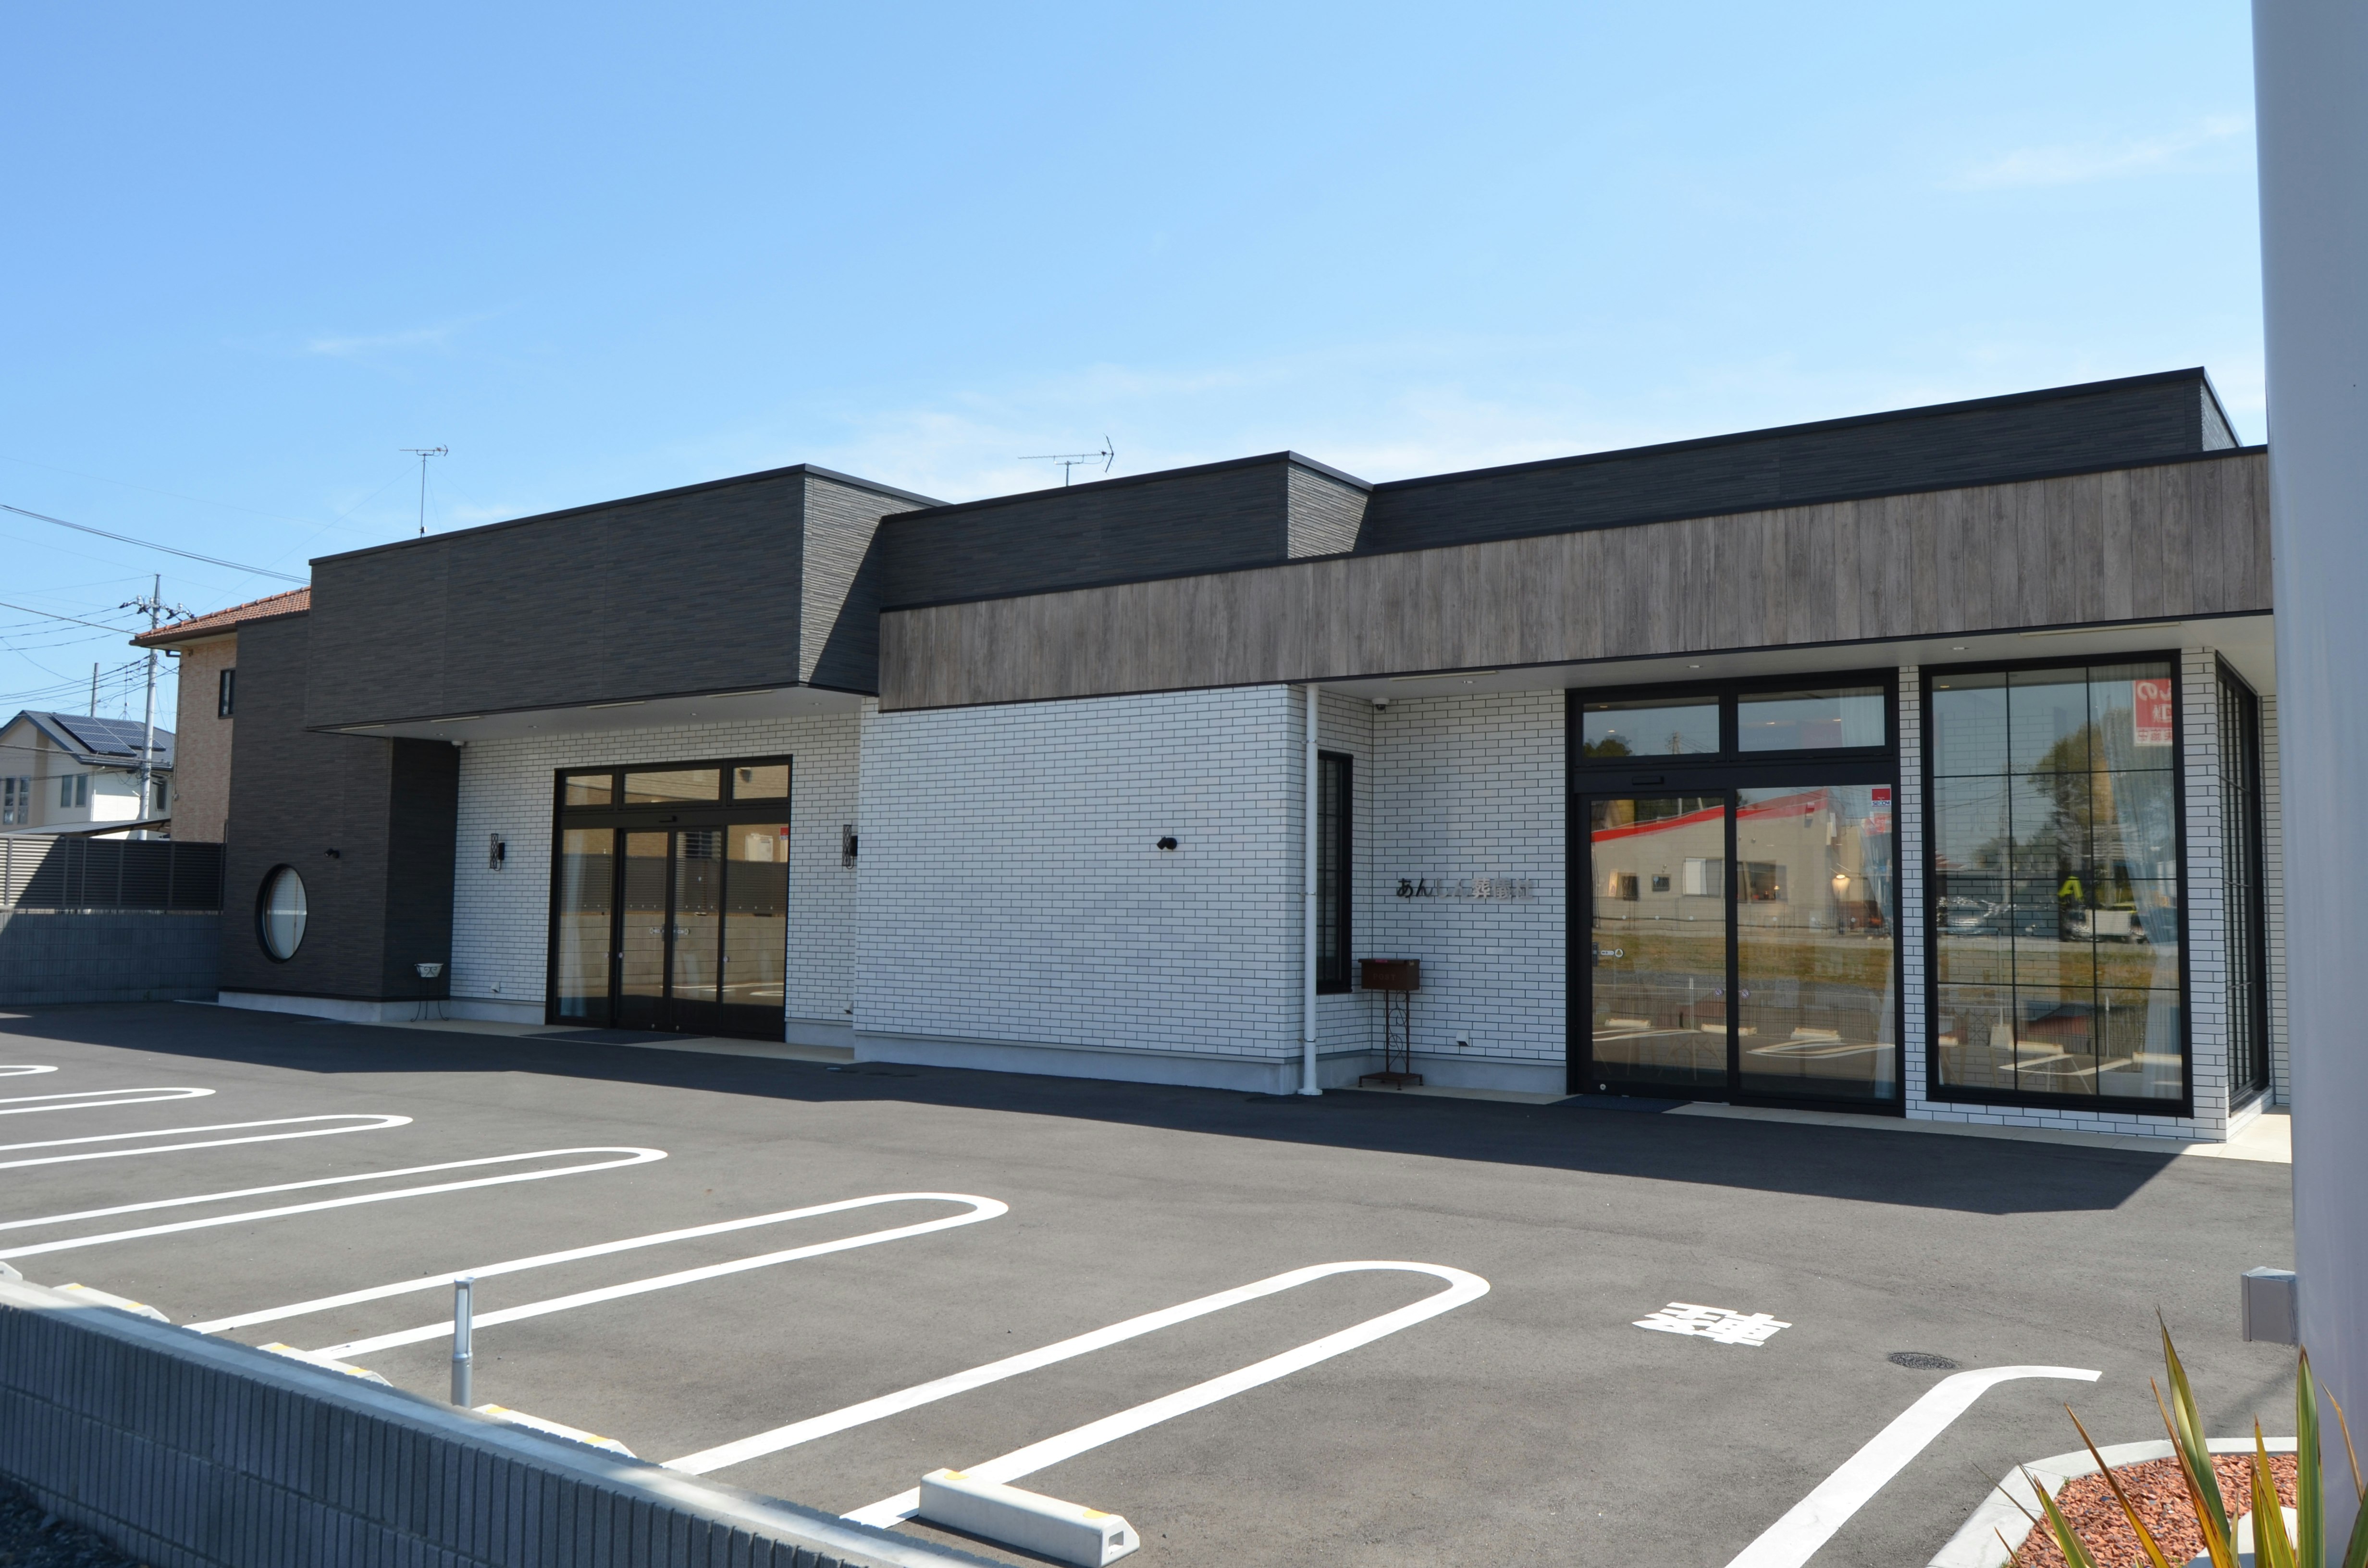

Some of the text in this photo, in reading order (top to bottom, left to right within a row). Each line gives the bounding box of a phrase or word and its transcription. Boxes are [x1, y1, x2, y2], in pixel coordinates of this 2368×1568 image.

[1396, 877, 1534, 900] あんしん葬儀社
